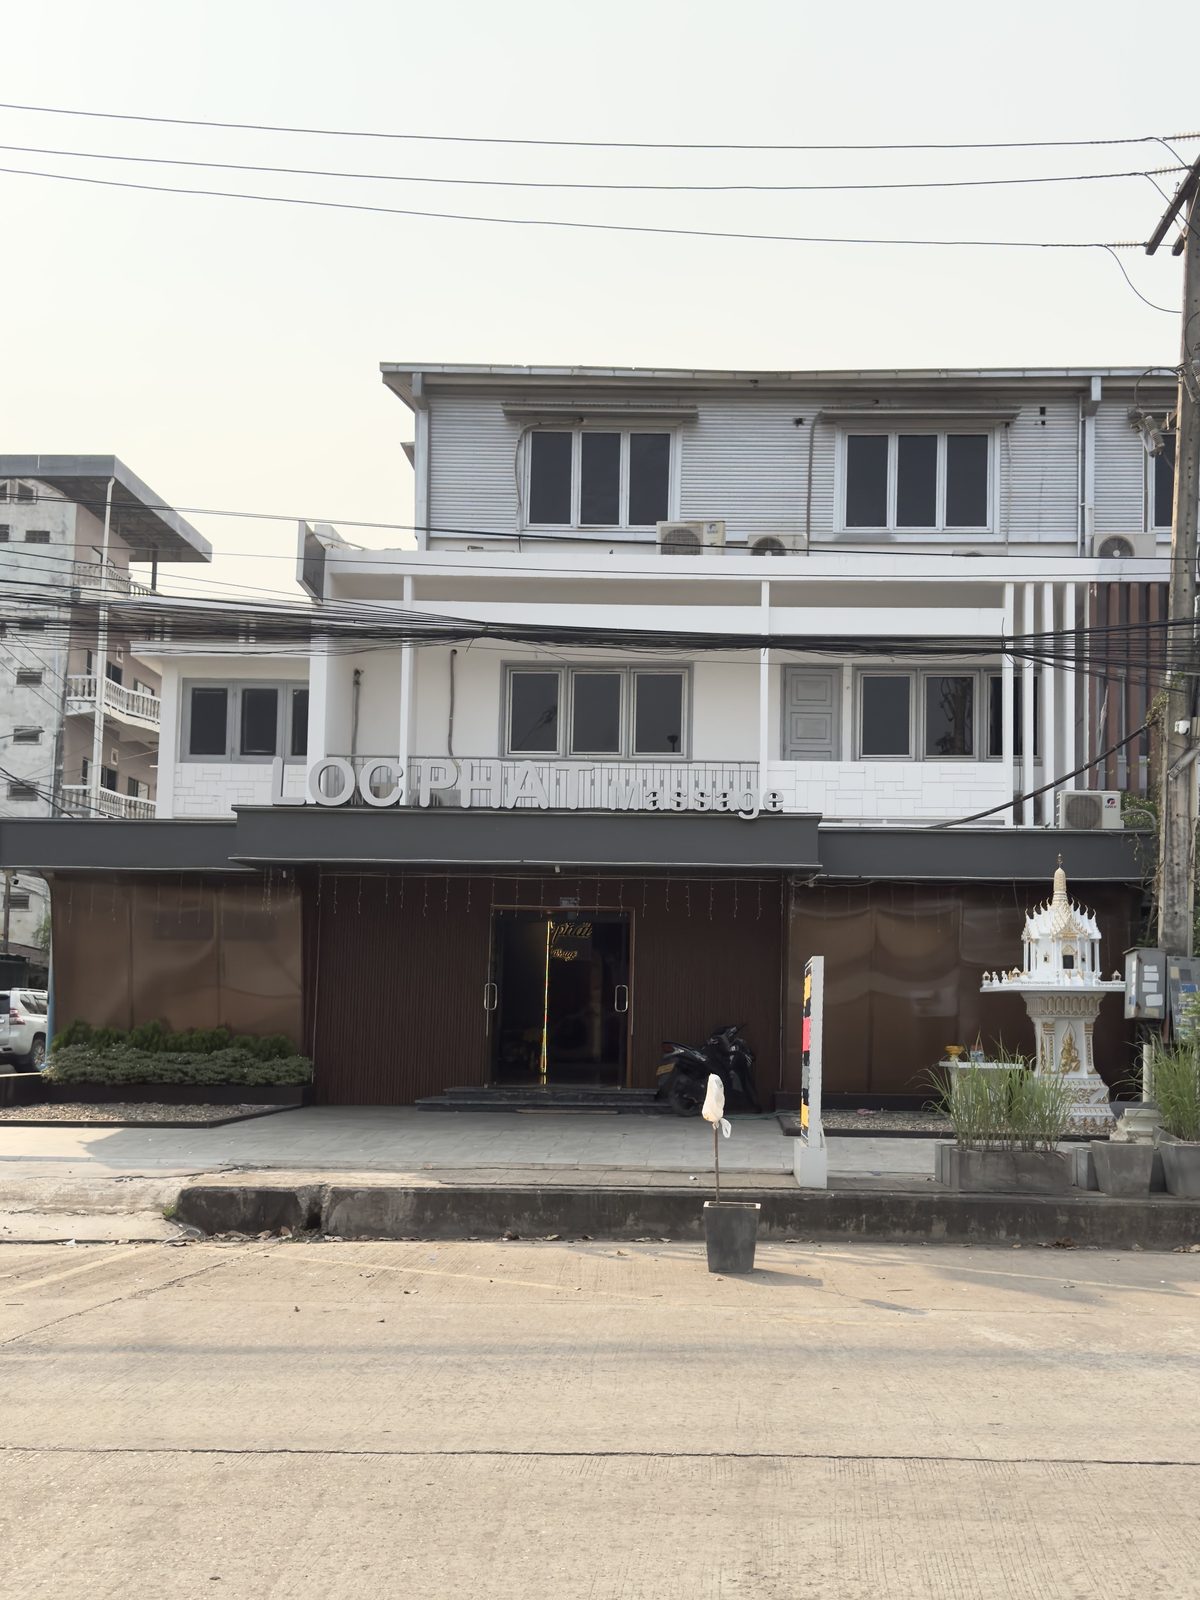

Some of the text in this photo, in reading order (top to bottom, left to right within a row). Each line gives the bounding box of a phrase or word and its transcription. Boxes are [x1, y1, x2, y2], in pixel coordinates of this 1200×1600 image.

[272, 756, 784, 820] LOC PHAT Massage
